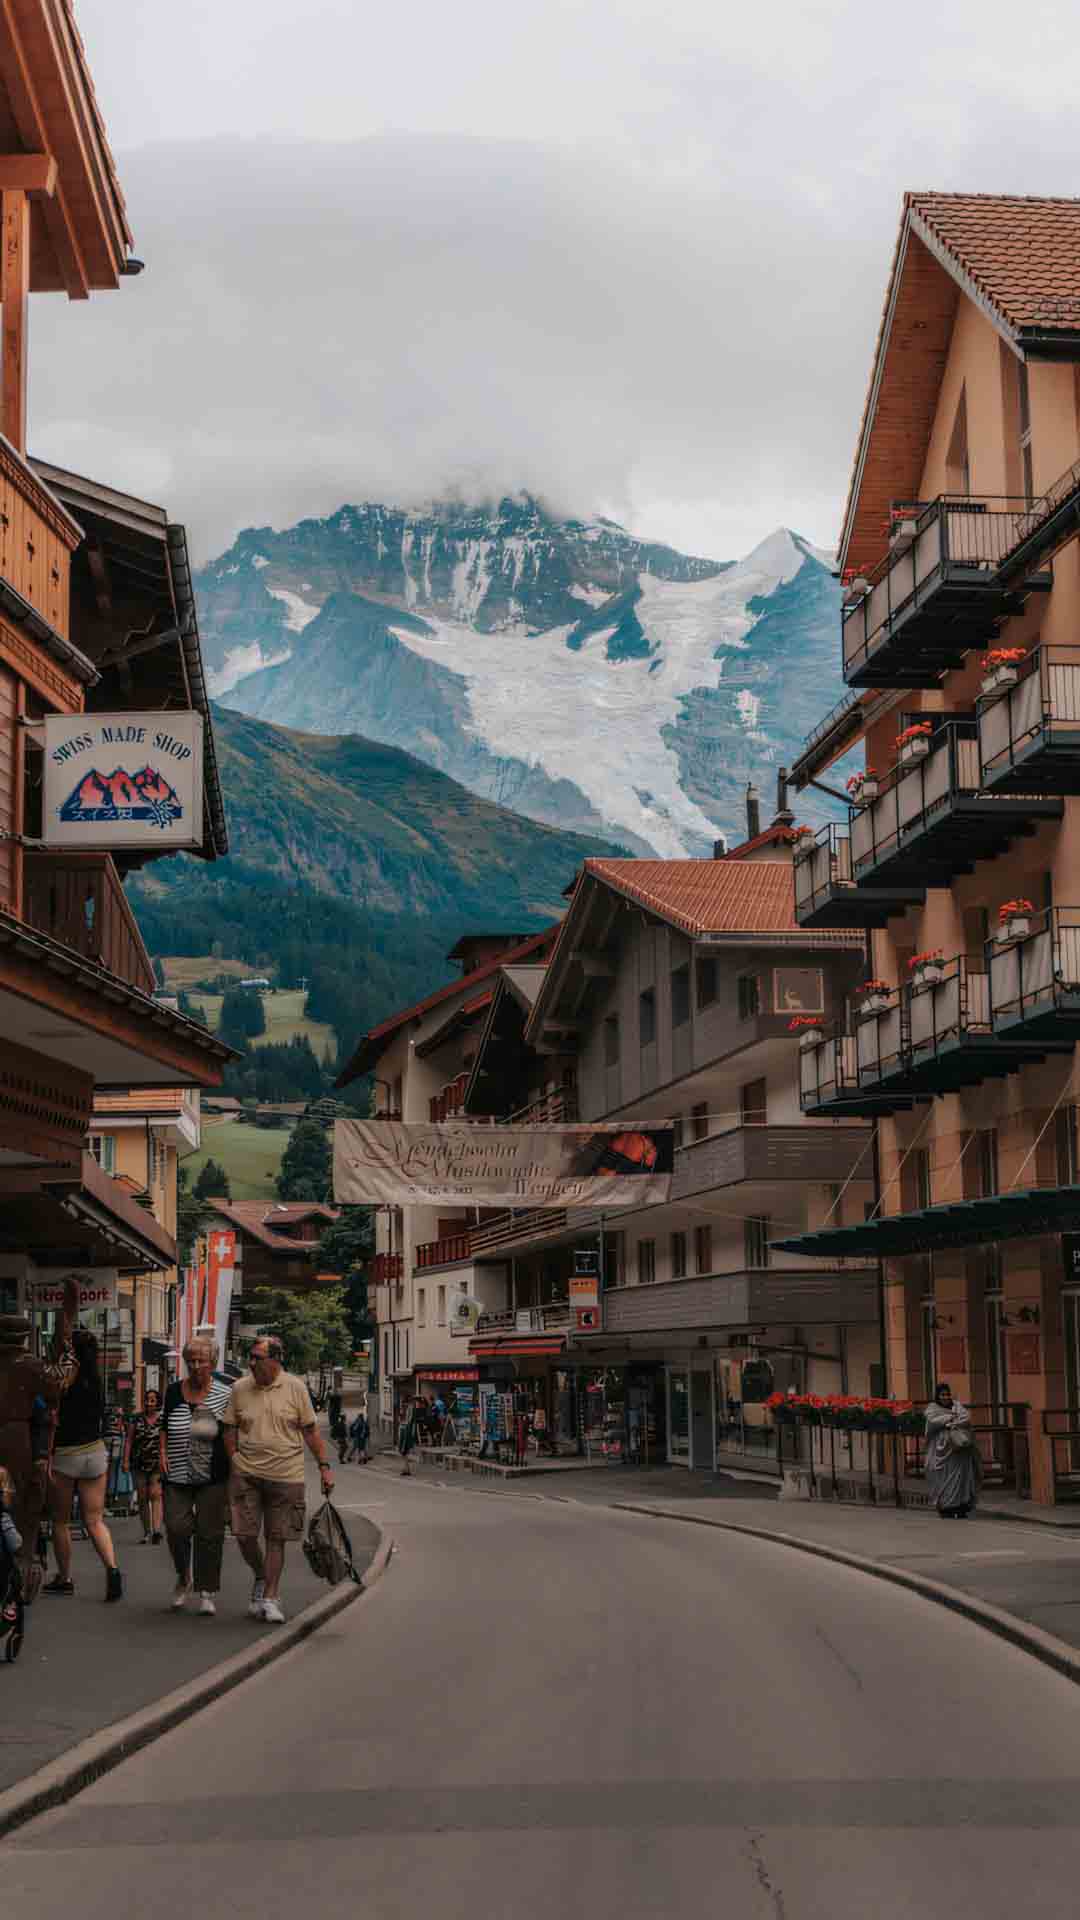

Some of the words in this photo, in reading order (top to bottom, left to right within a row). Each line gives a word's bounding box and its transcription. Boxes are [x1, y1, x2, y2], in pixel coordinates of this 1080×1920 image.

[52, 733, 94, 766] SWISS
[102, 726, 147, 744] MADE
[152, 733, 192, 760] SHOP
